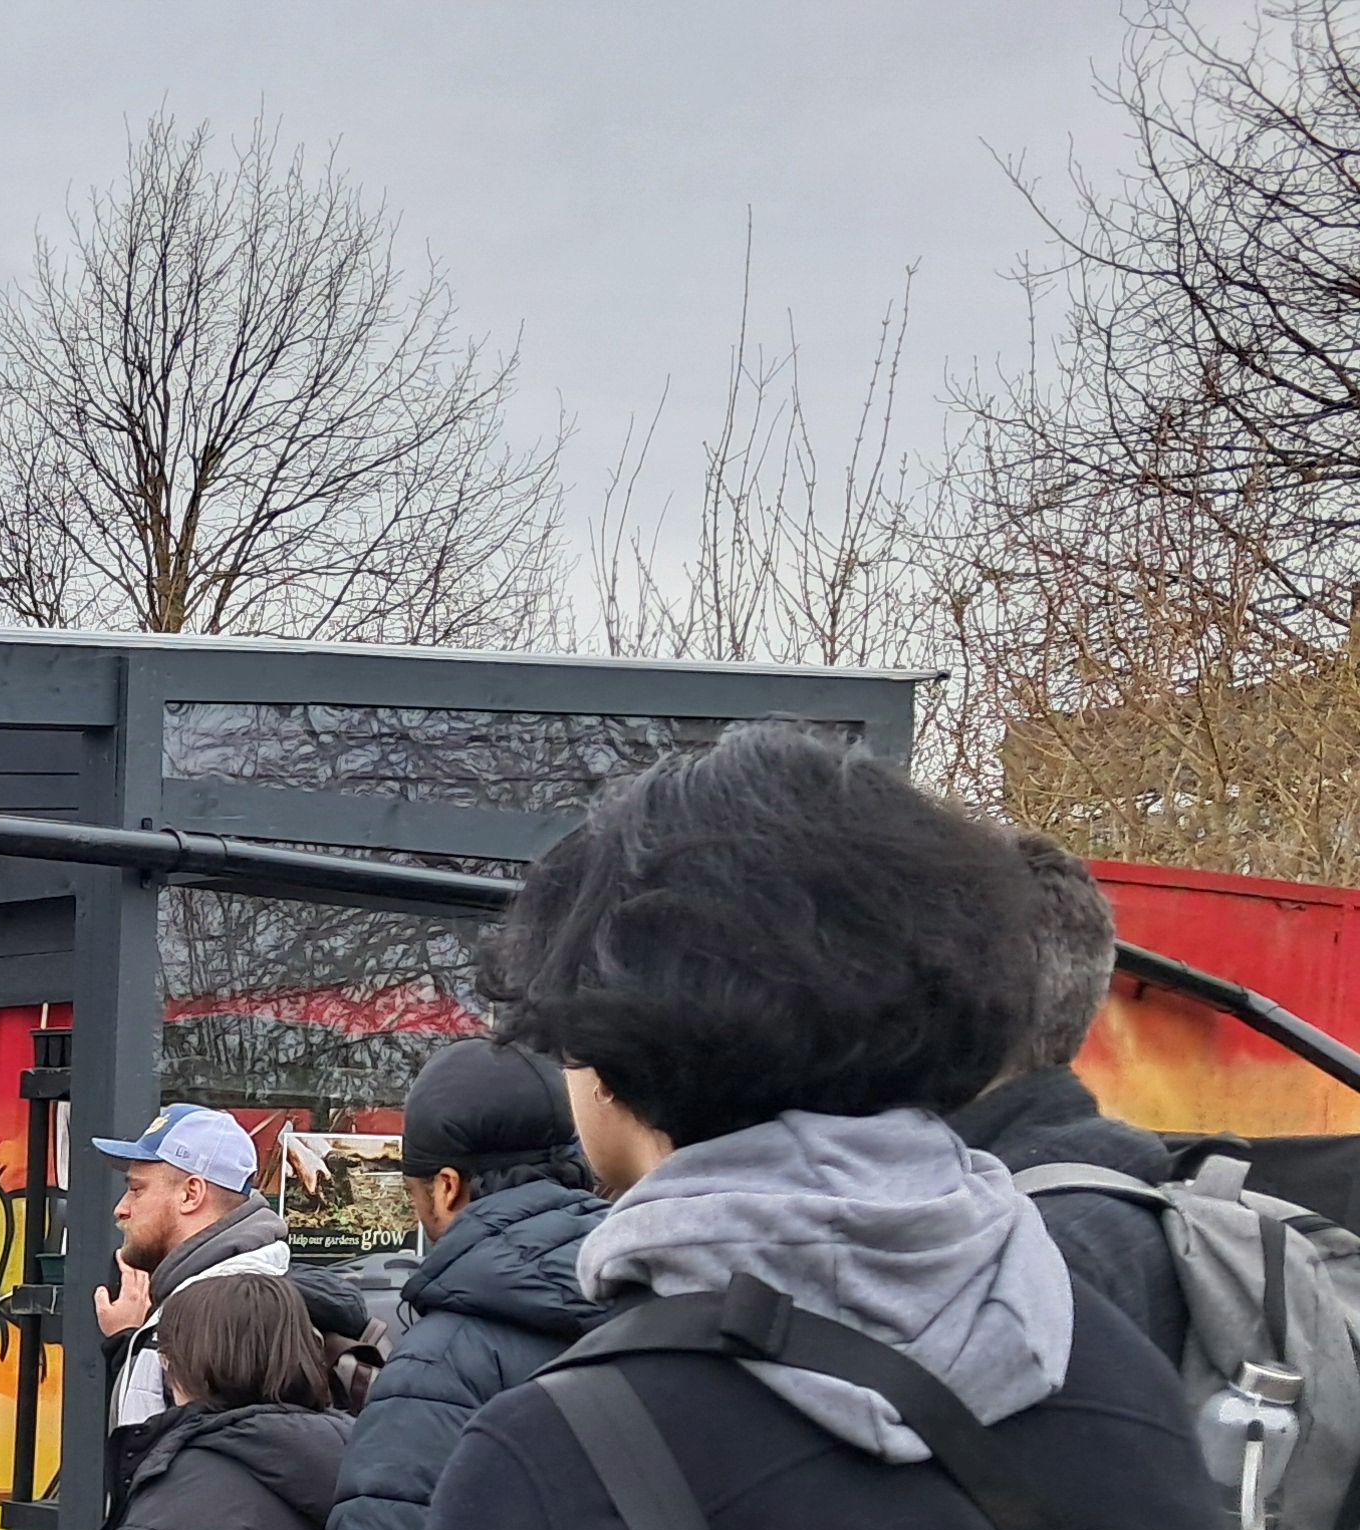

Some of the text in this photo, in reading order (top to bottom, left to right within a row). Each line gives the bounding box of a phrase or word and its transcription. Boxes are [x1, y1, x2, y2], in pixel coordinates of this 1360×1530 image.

[288, 1229, 406, 1251] Help our gardens grow
